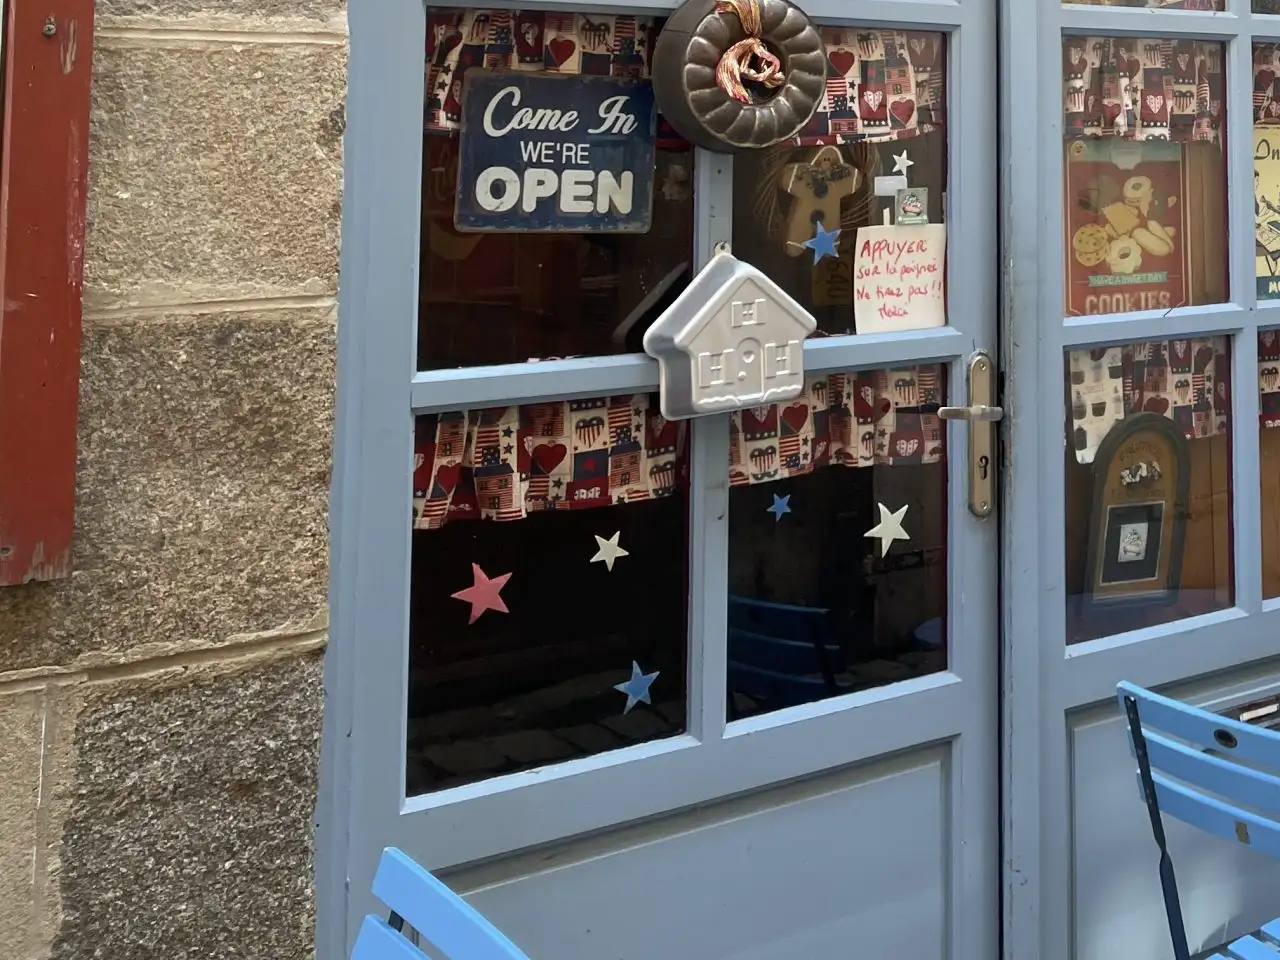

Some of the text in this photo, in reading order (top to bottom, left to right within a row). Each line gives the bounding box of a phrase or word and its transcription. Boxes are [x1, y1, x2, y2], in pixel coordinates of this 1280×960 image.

[483, 86, 638, 137] Come In
[520, 141, 590, 164] WE'RE
[1254, 139, 1280, 160] In
[475, 166, 634, 214] OPEN
[860, 239, 927, 264] APPUYER
[1085, 290, 1171, 315] COOKIES
